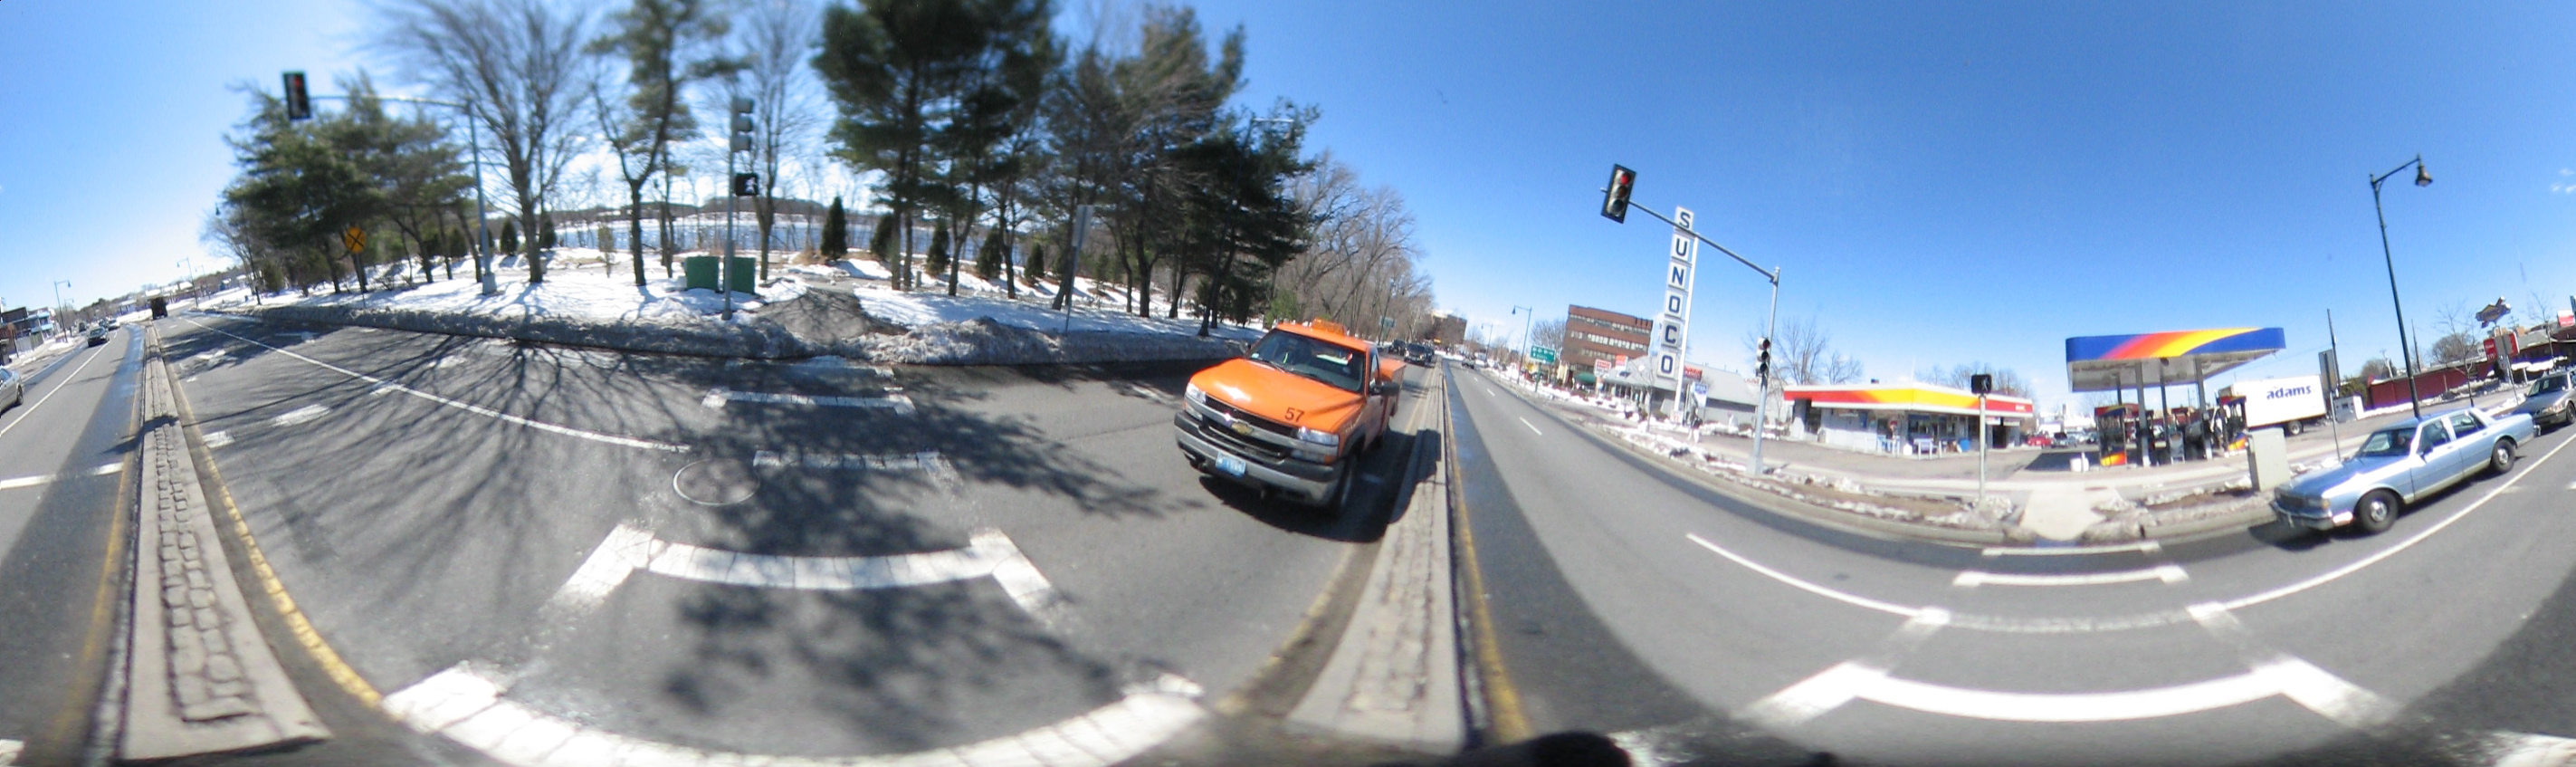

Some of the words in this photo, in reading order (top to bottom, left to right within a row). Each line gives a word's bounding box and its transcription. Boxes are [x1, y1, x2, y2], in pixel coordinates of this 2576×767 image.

[1660, 211, 1692, 375] SUNOCO
[2266, 385, 2312, 399] adams
[1283, 407, 1305, 422] 57
